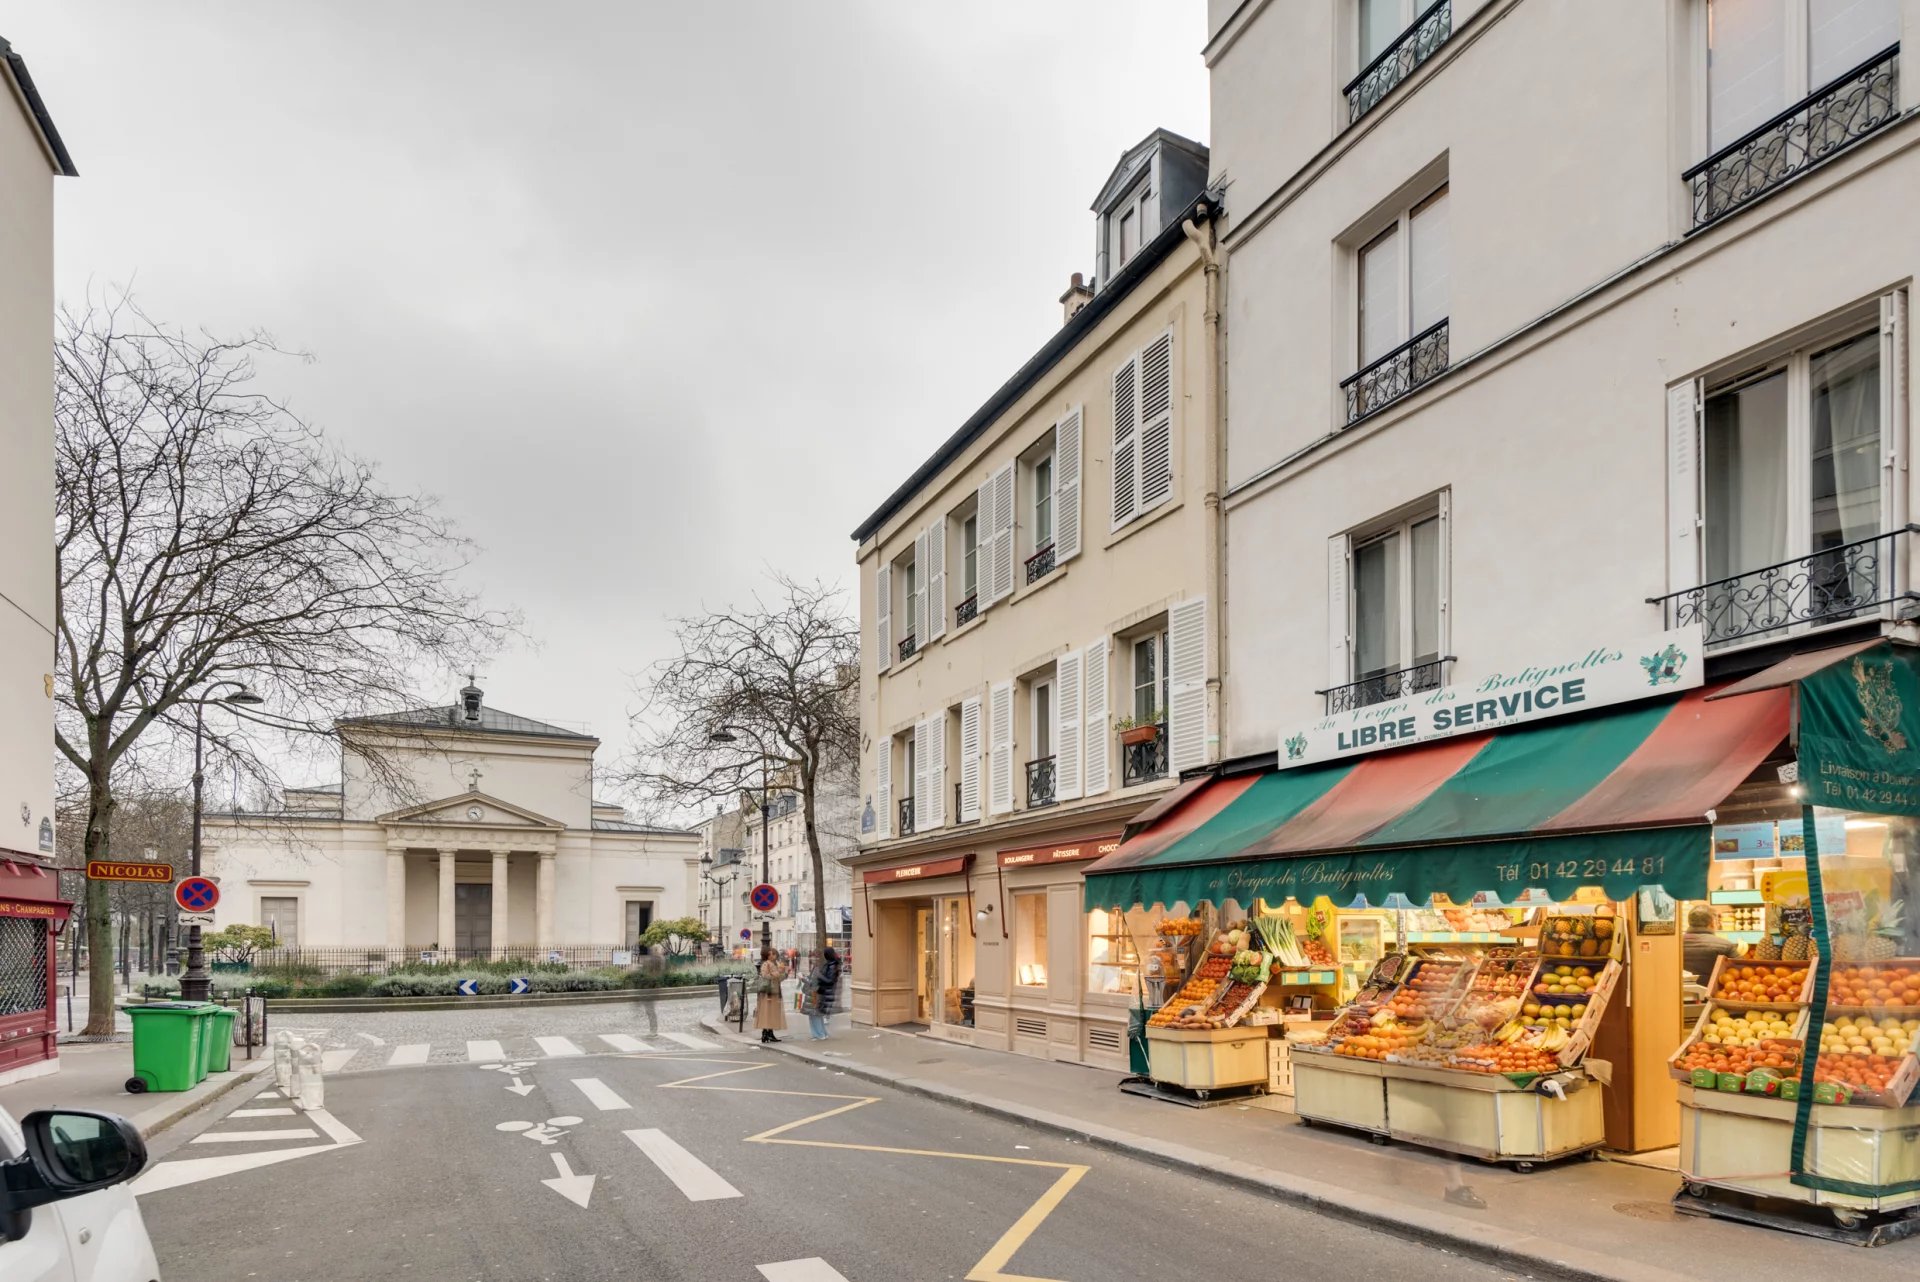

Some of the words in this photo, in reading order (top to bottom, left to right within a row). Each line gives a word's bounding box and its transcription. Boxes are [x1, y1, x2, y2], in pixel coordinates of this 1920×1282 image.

[1352, 703, 1408, 723] Verger
[1425, 688, 1456, 706] des
[1476, 647, 1624, 692] Batignolles
[1338, 716, 1416, 750] LIBRE
[1433, 678, 1586, 731] SERVICE
[1820, 760, 1870, 781] Livraison
[1847, 785, 1859, 800] 01
[1862, 788, 1876, 802] 42
[1052, 848, 1080, 858] PÂTISSERIE
[97, 865, 164, 878] NICOLAS
[1228, 865, 1274, 893] Verger
[1277, 868, 1296, 885] des
[1301, 861, 1395, 891] Batignolles
[1497, 863, 1519, 881] Tél
[1530, 863, 1549, 880] 01
[1556, 861, 1578, 878] 42
[1583, 860, 1607, 877] 29
[1612, 858, 1635, 875] 44
[1641, 856, 1665, 875] 81
